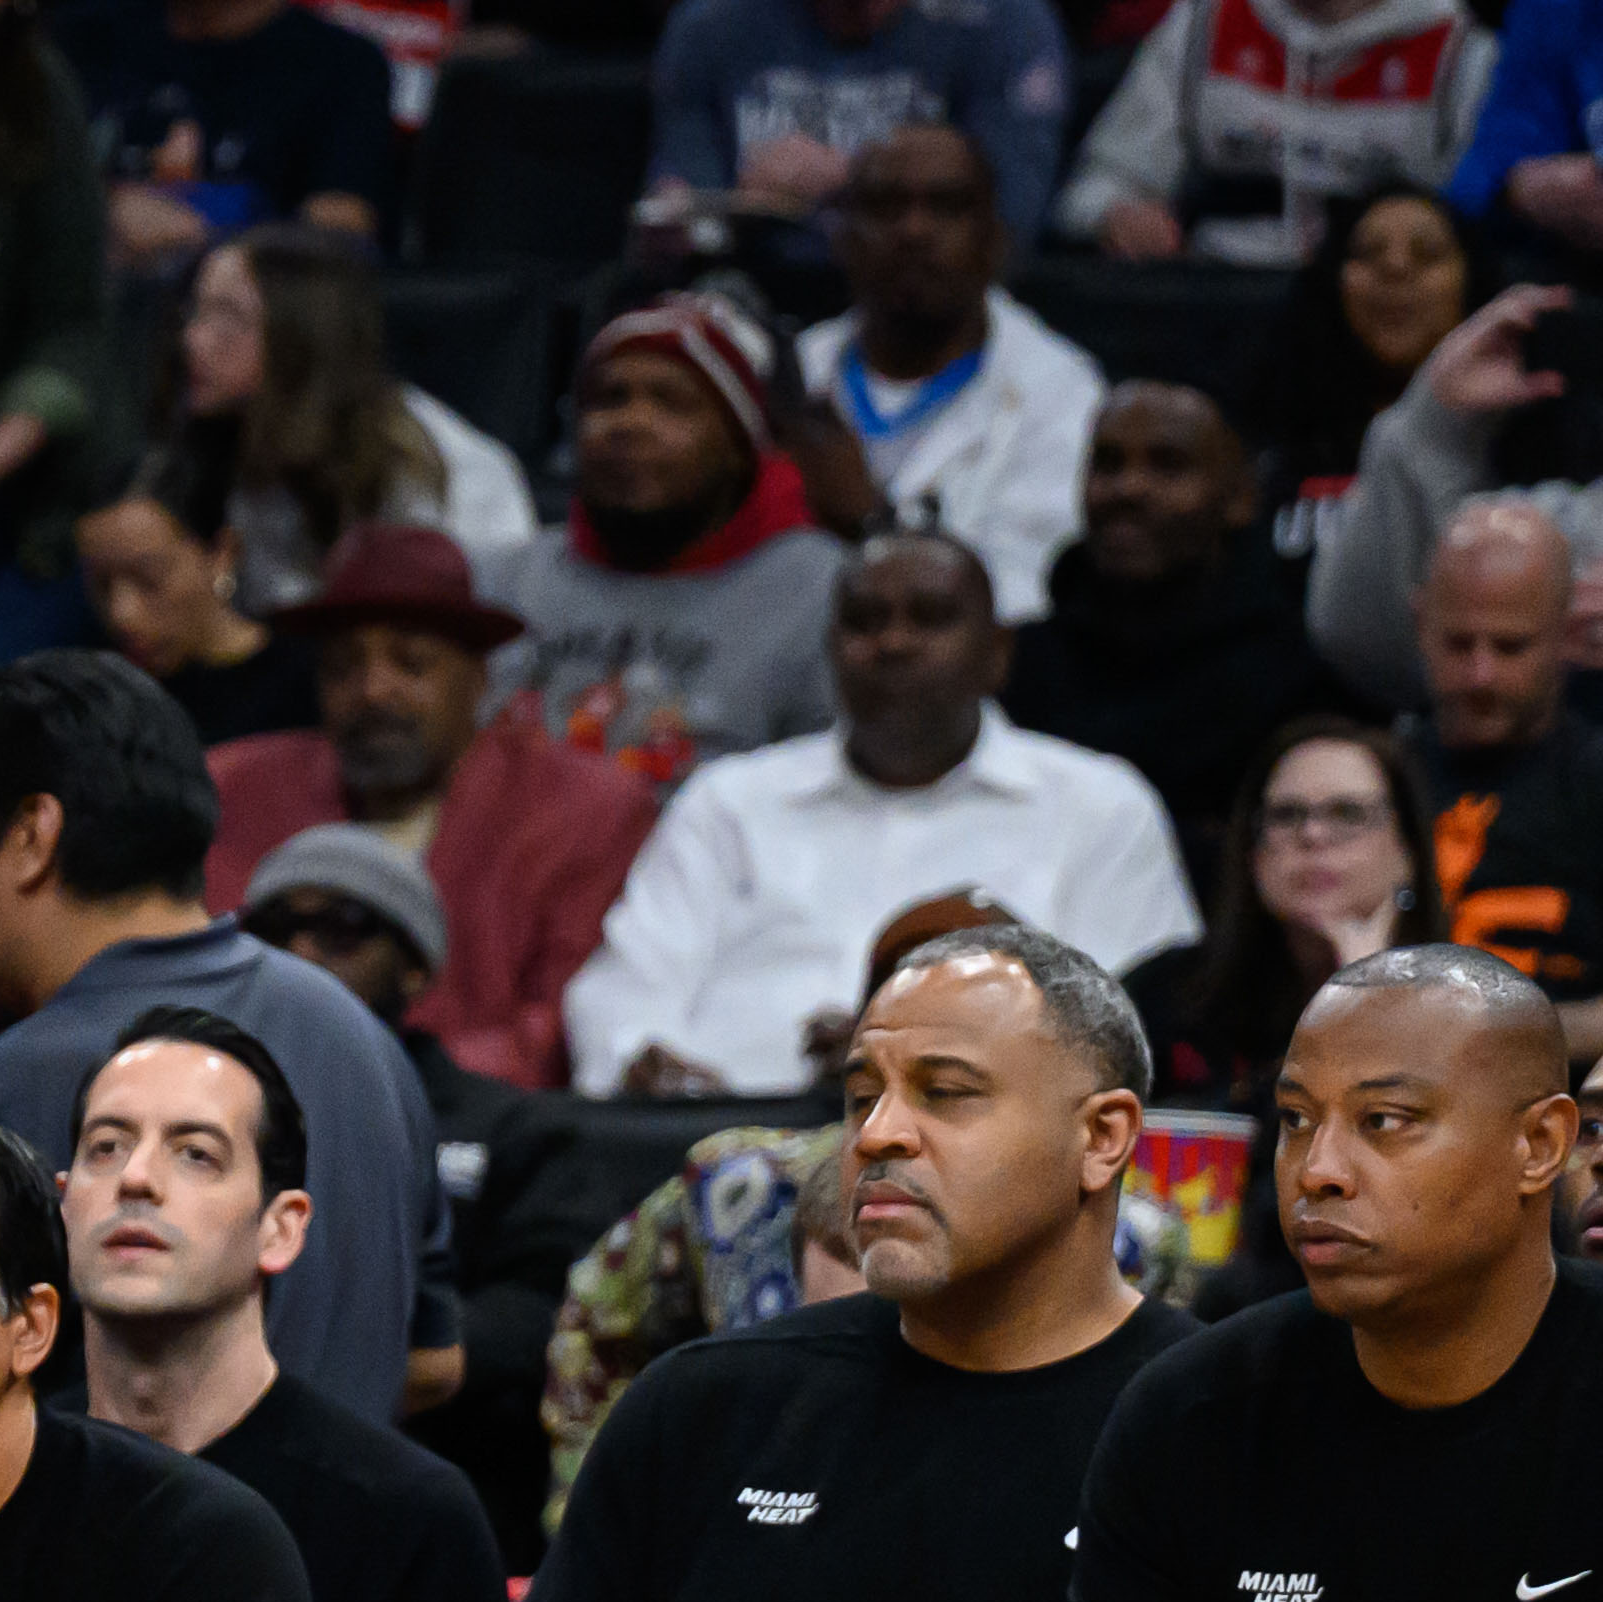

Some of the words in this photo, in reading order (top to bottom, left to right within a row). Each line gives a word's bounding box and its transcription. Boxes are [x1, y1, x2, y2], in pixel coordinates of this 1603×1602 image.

[737, 1487, 816, 1507] MIAMI
[747, 1503, 820, 1525] HEAT
[1237, 1570, 1317, 1593] MIAMI
